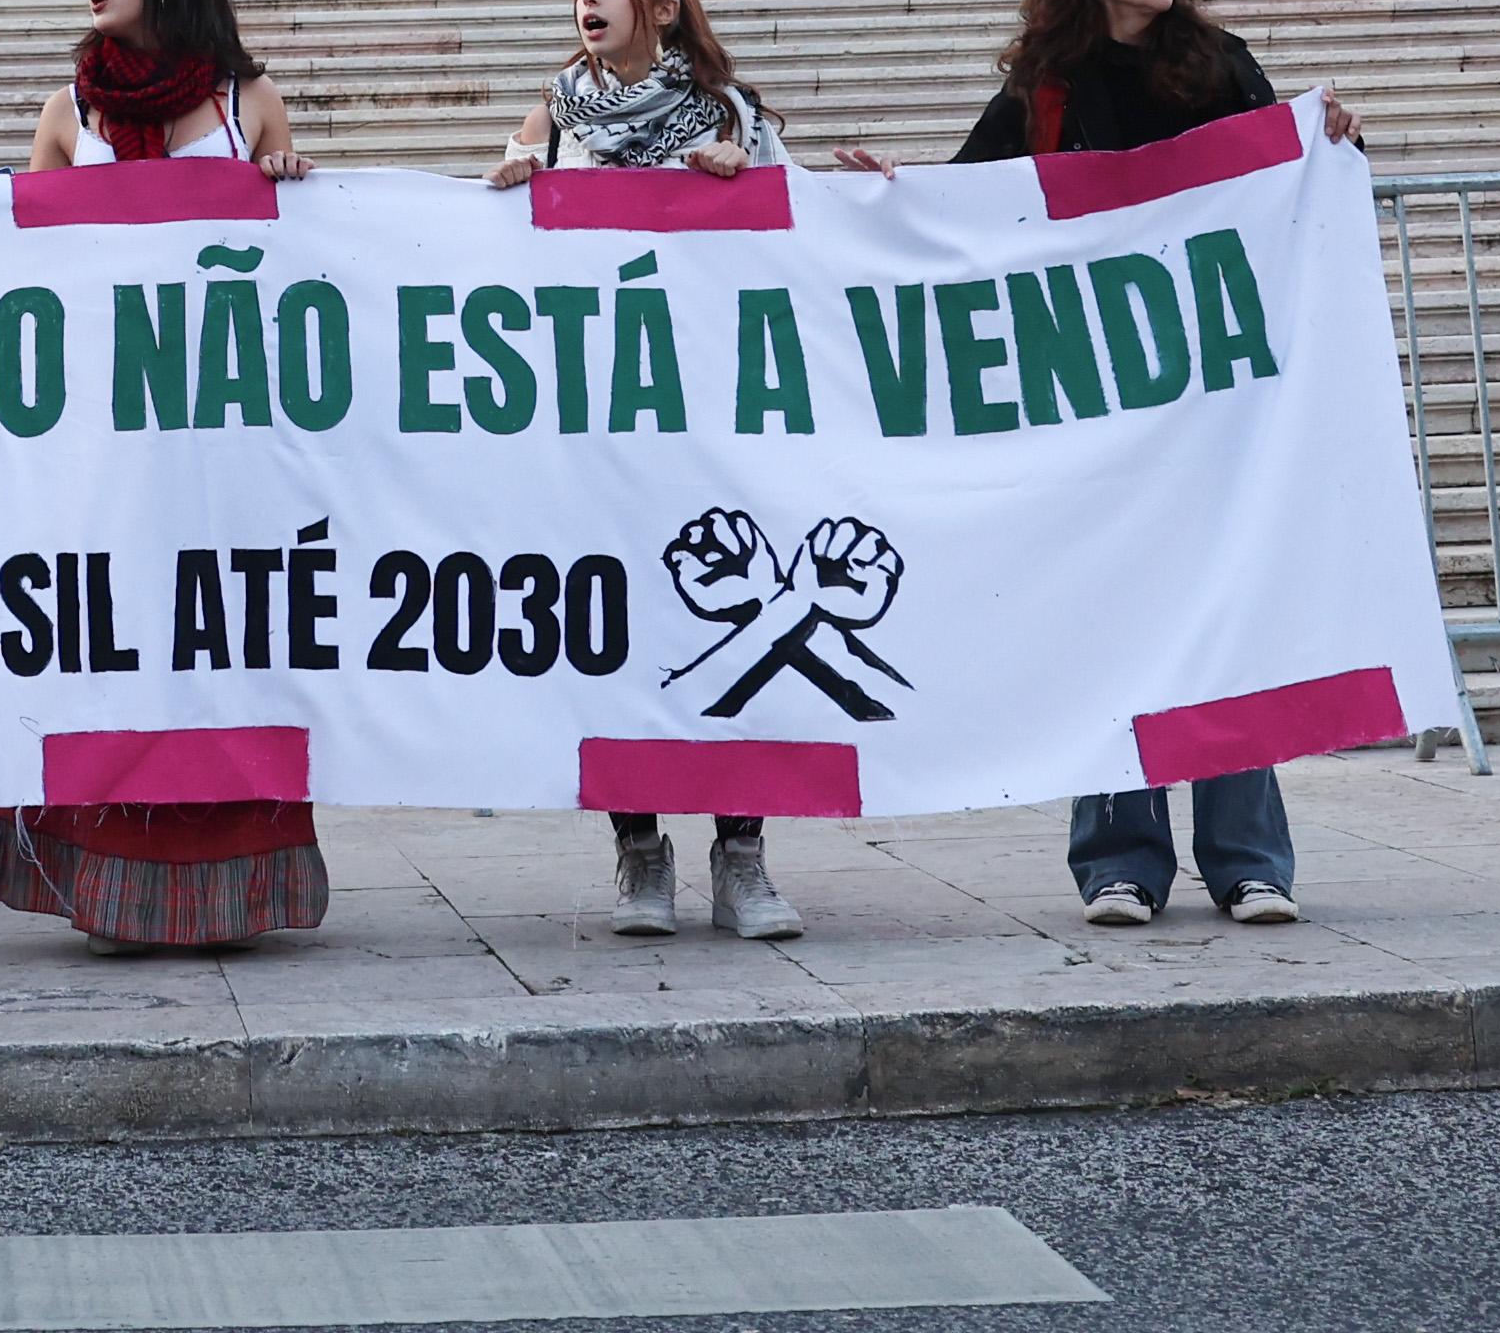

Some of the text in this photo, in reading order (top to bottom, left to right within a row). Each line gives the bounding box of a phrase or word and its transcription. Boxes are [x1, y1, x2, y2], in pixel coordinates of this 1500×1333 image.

[112, 244, 353, 432] NÃO
[396, 249, 687, 435] ESTÁ
[735, 288, 815, 435] A
[845, 228, 1280, 438] VENDA
[171, 517, 339, 672] ATÉ
[366, 550, 630, 677] 2030
